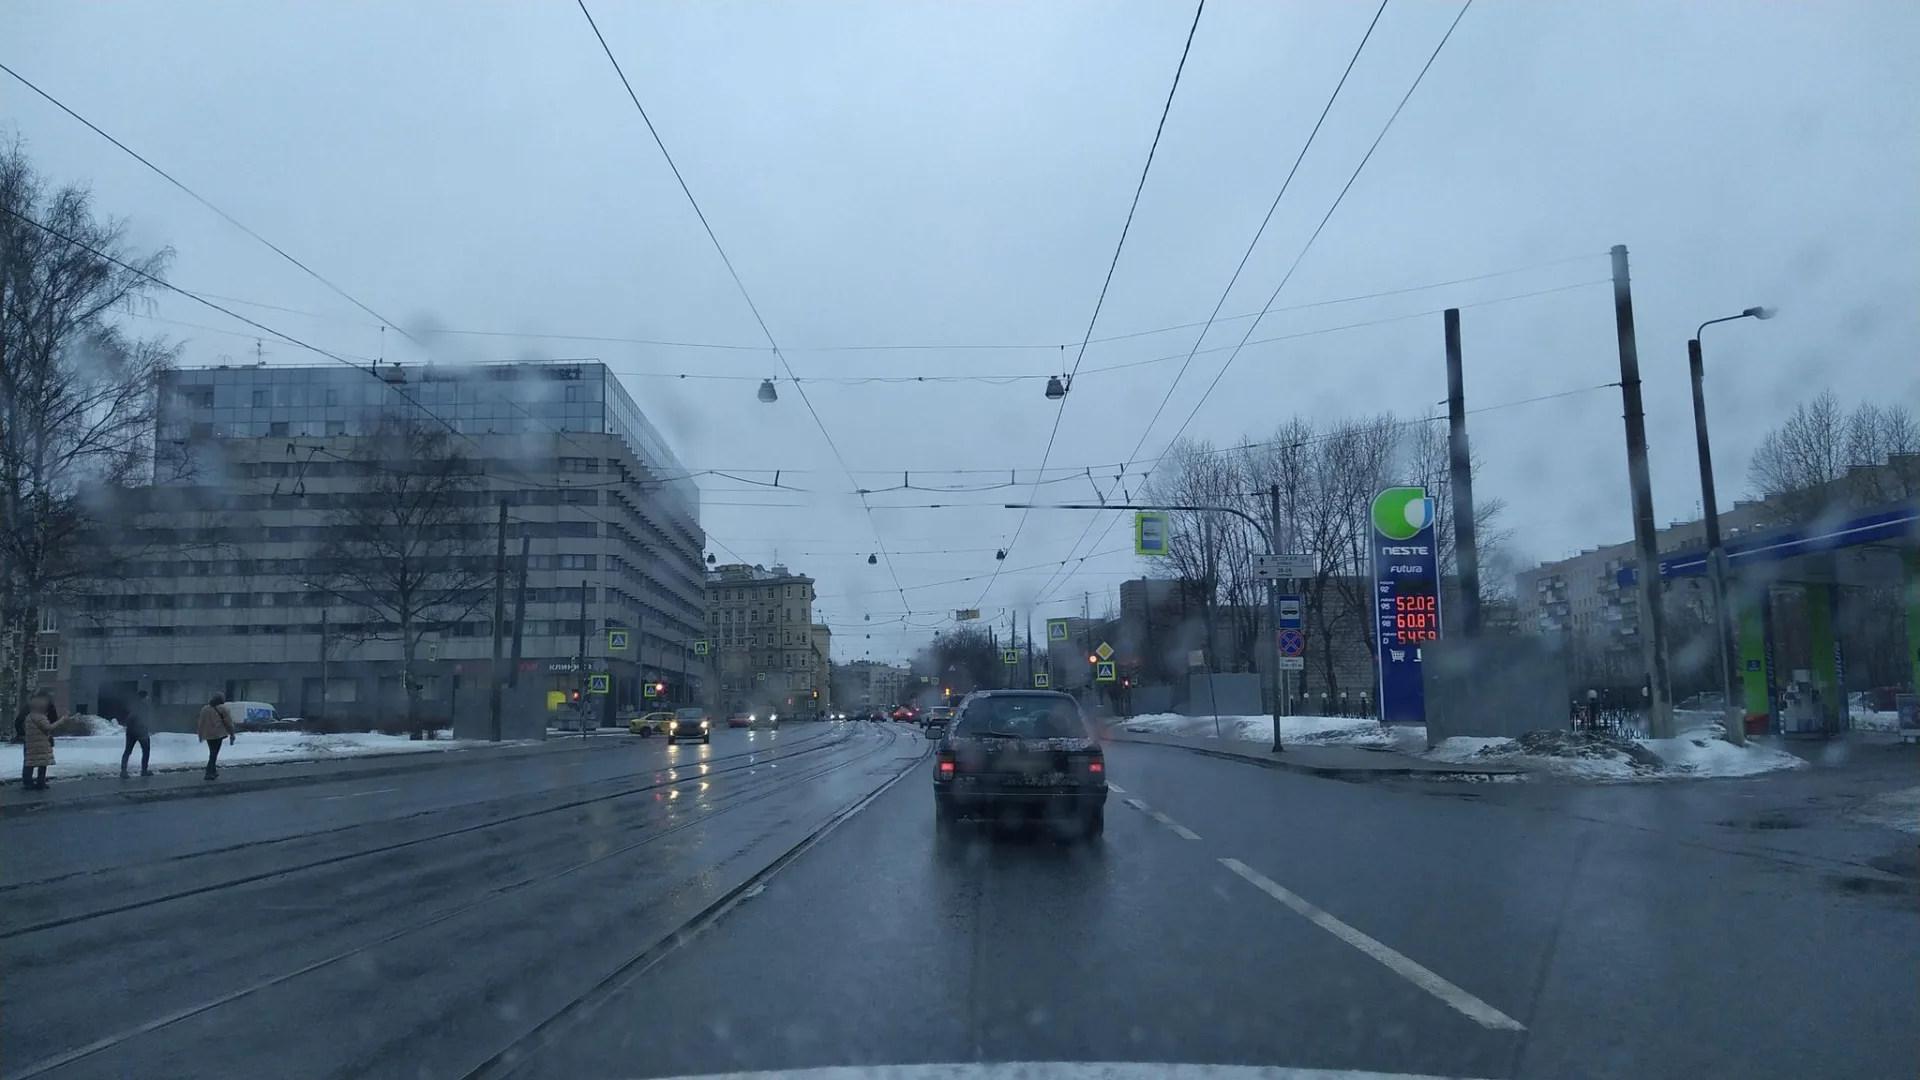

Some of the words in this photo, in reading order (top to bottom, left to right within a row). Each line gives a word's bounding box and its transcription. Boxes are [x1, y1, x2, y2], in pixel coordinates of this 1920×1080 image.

[1382, 546, 1429, 555] NESTE
[1390, 565, 1423, 573] Futura
[1396, 596, 1436, 611] 52.02
[1397, 613, 1437, 628] 60.87
